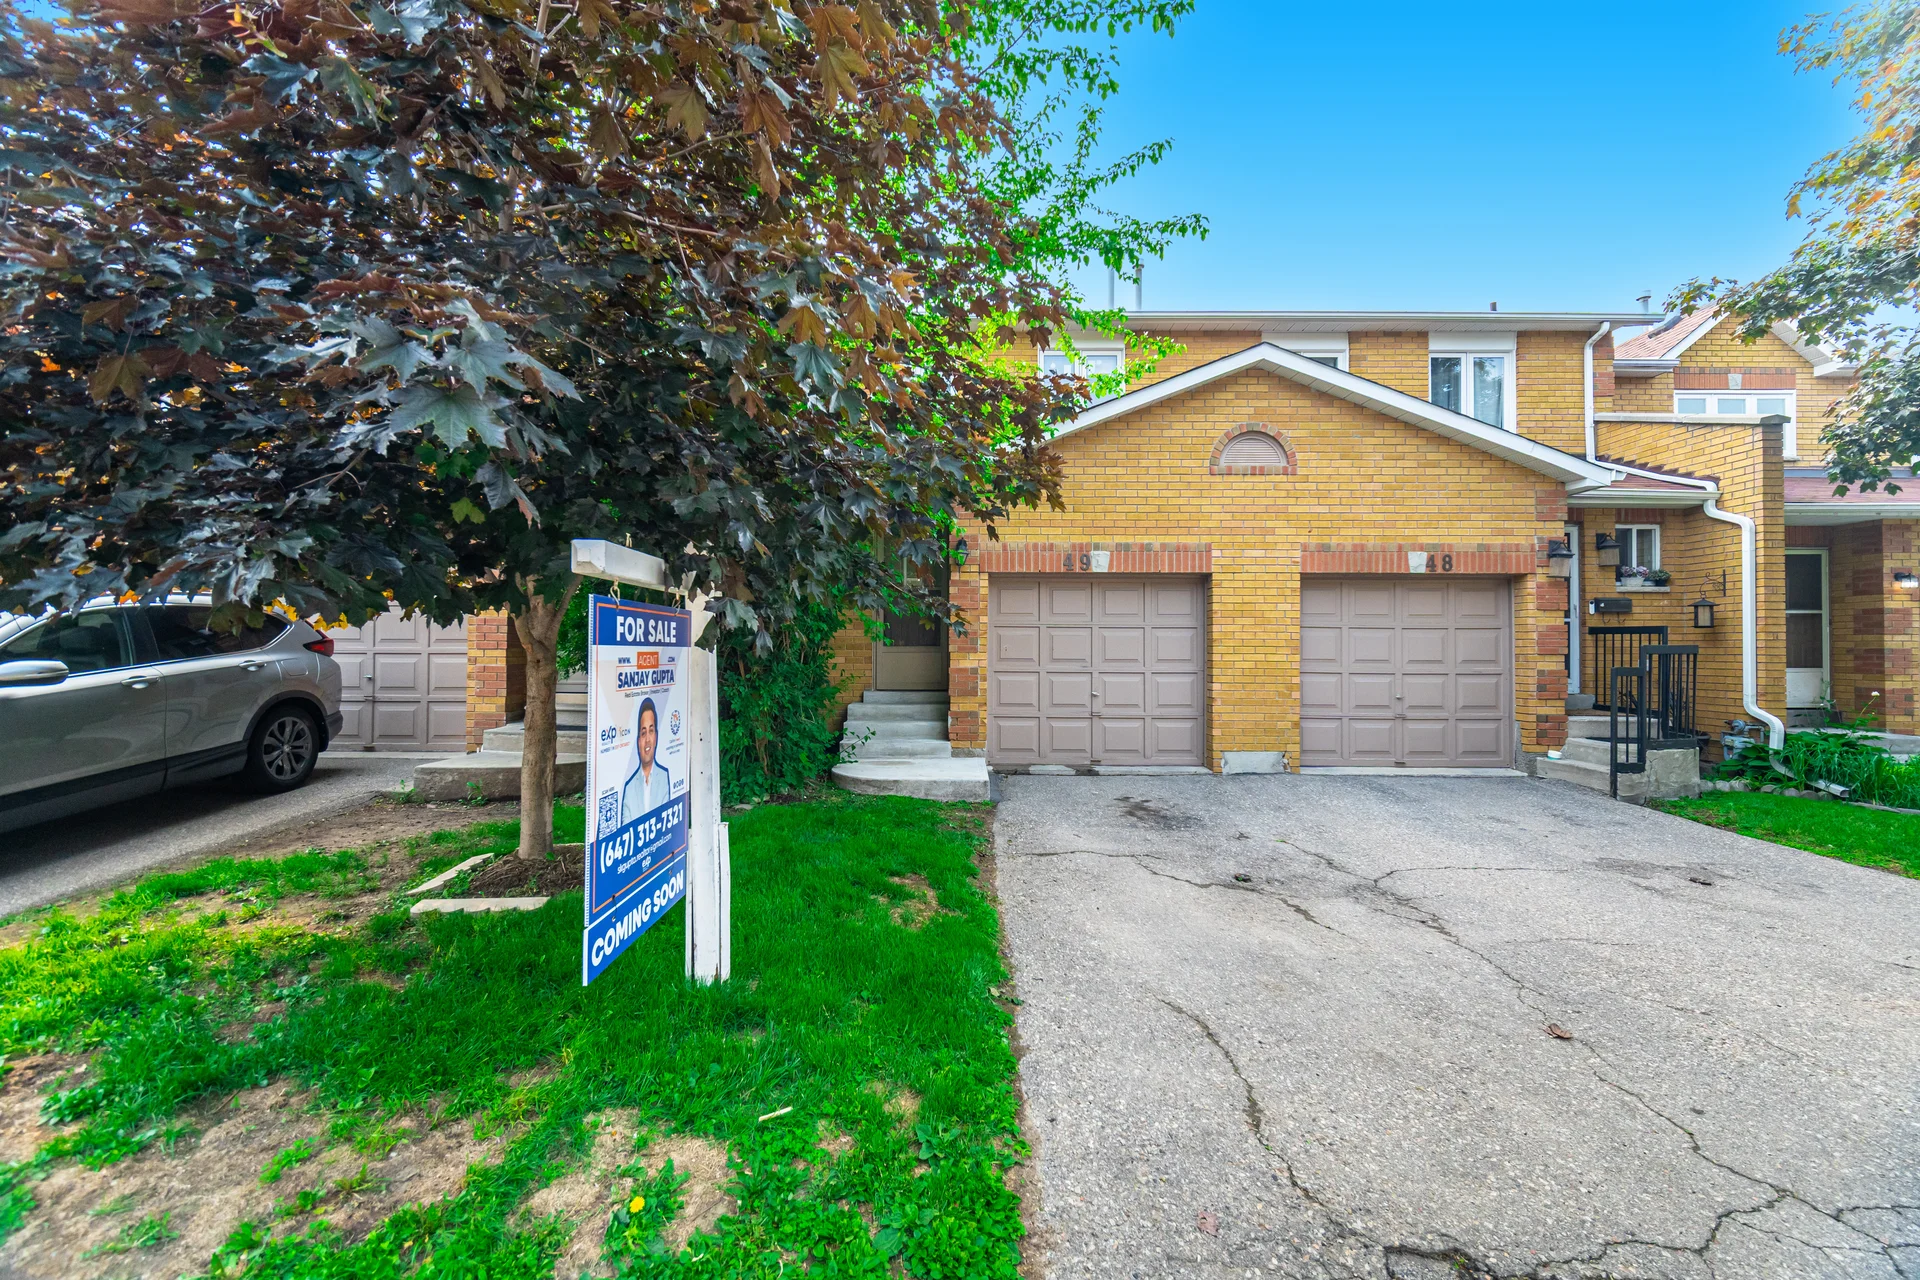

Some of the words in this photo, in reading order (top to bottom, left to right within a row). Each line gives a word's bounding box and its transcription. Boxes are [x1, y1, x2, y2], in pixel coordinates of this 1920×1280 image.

[1063, 553, 1091, 571] 49
[1426, 553, 1453, 572] 48
[616, 615, 645, 642] FOR
[648, 619, 677, 643] SALE
[638, 654, 658, 666] AGENT
[618, 670, 650, 689] SANJAY
[651, 669, 675, 685] GUPTA
[600, 826, 634, 874] (647)
[637, 802, 683, 847] 313-7321
[591, 897, 652, 967] COMING
[653, 869, 684, 913] SOON
